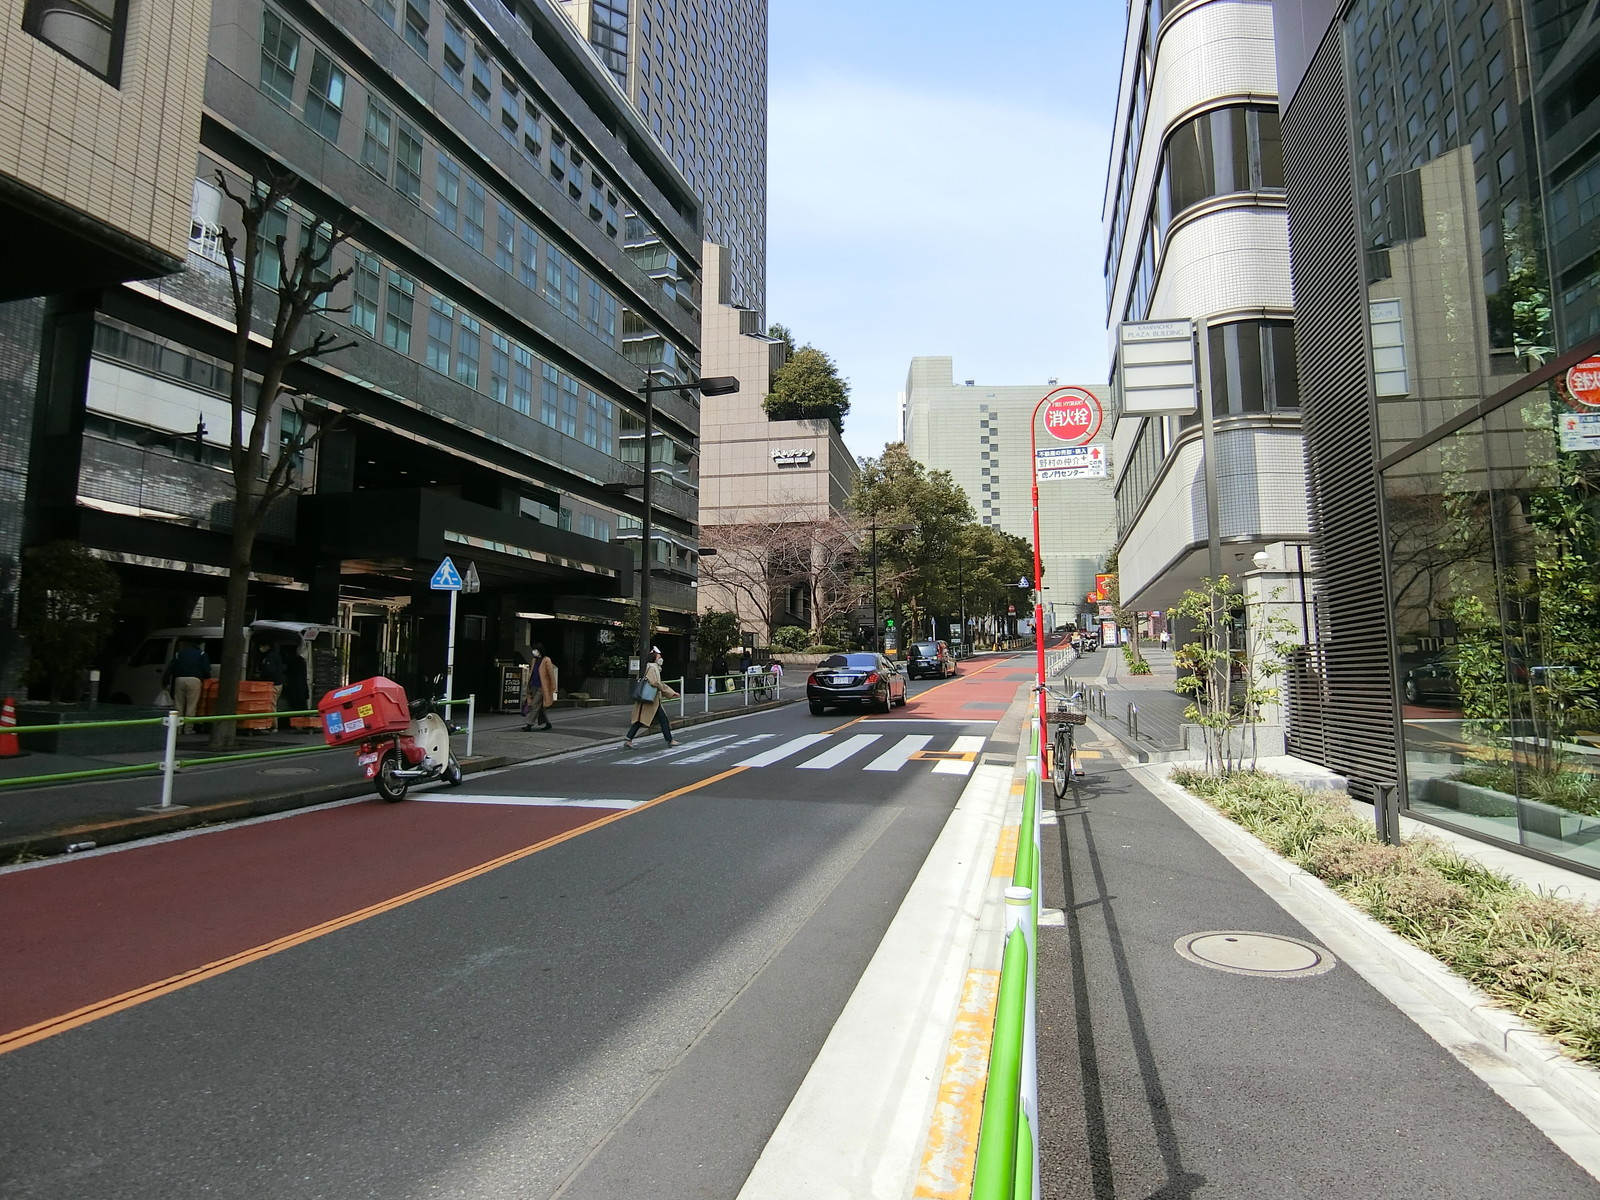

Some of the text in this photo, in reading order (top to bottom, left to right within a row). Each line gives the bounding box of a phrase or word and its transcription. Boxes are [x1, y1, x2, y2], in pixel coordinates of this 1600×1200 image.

[1048, 408, 1089, 428] 消火栓
[329, 724, 344, 734] 053
